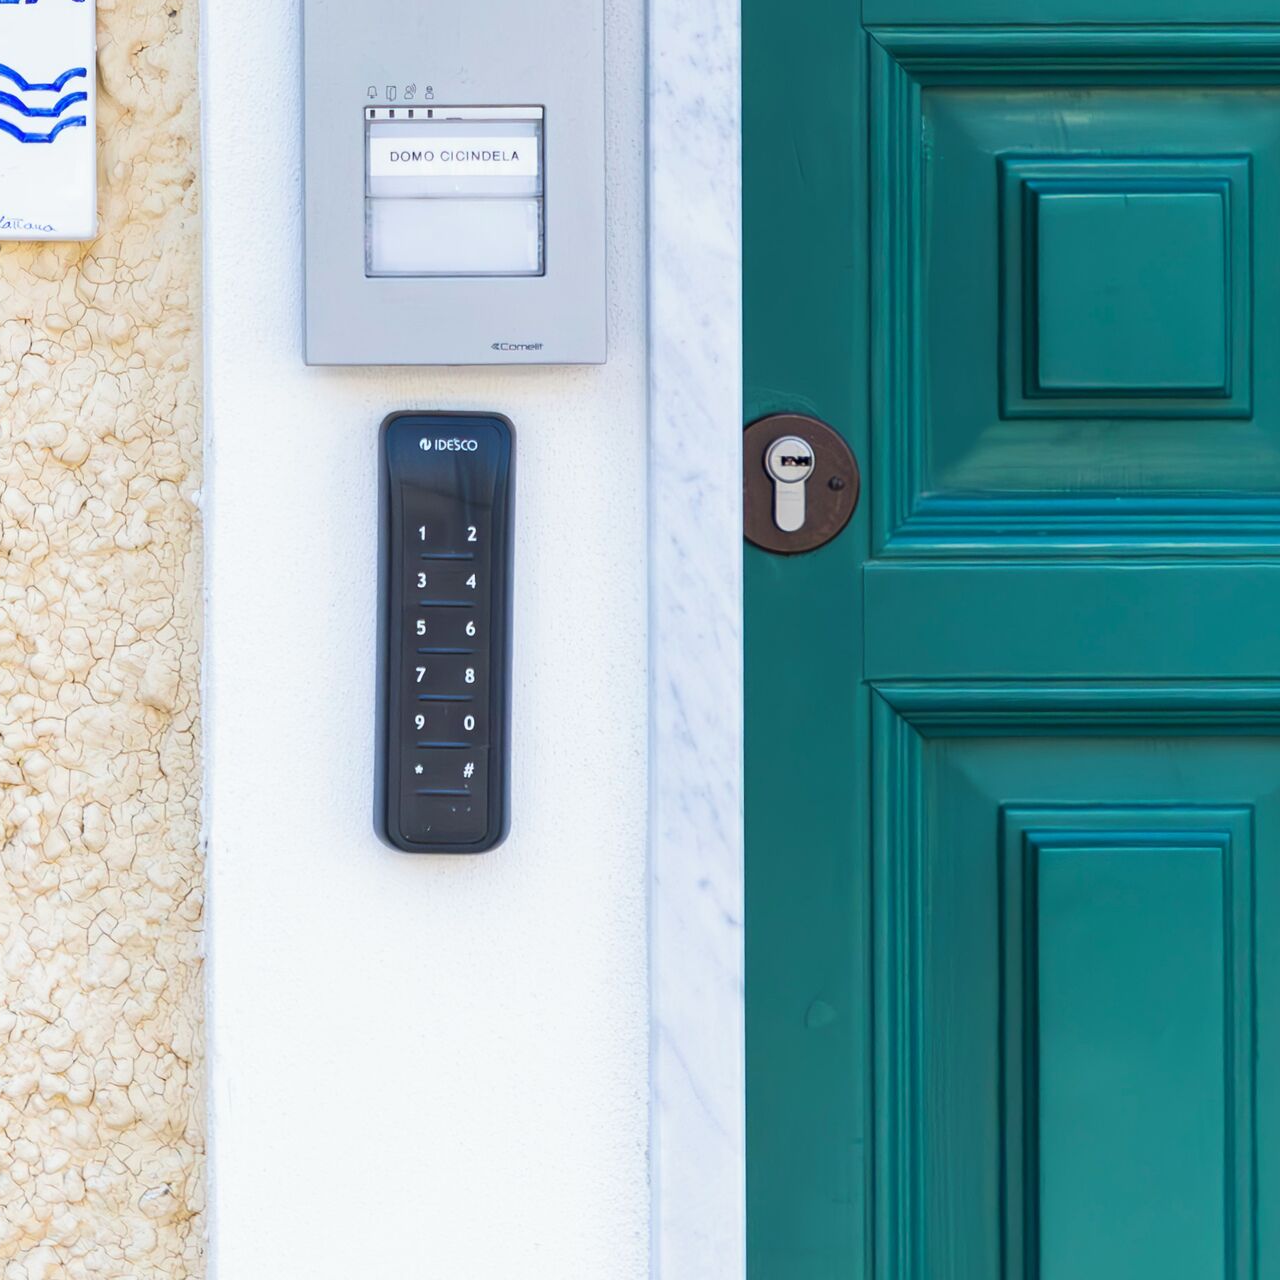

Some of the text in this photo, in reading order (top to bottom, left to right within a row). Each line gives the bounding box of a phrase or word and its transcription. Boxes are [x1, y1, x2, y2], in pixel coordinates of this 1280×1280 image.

[390, 150, 520, 162] DOMO CICINDELA
[500, 342, 544, 351] Comelit
[434, 438, 478, 452] IDESCO
[418, 525, 477, 542] 1 2
[417, 572, 477, 589] 3 4
[416, 619, 476, 637] 5 6
[415, 666, 475, 684] 7 8
[414, 714, 475, 731] 9 0
